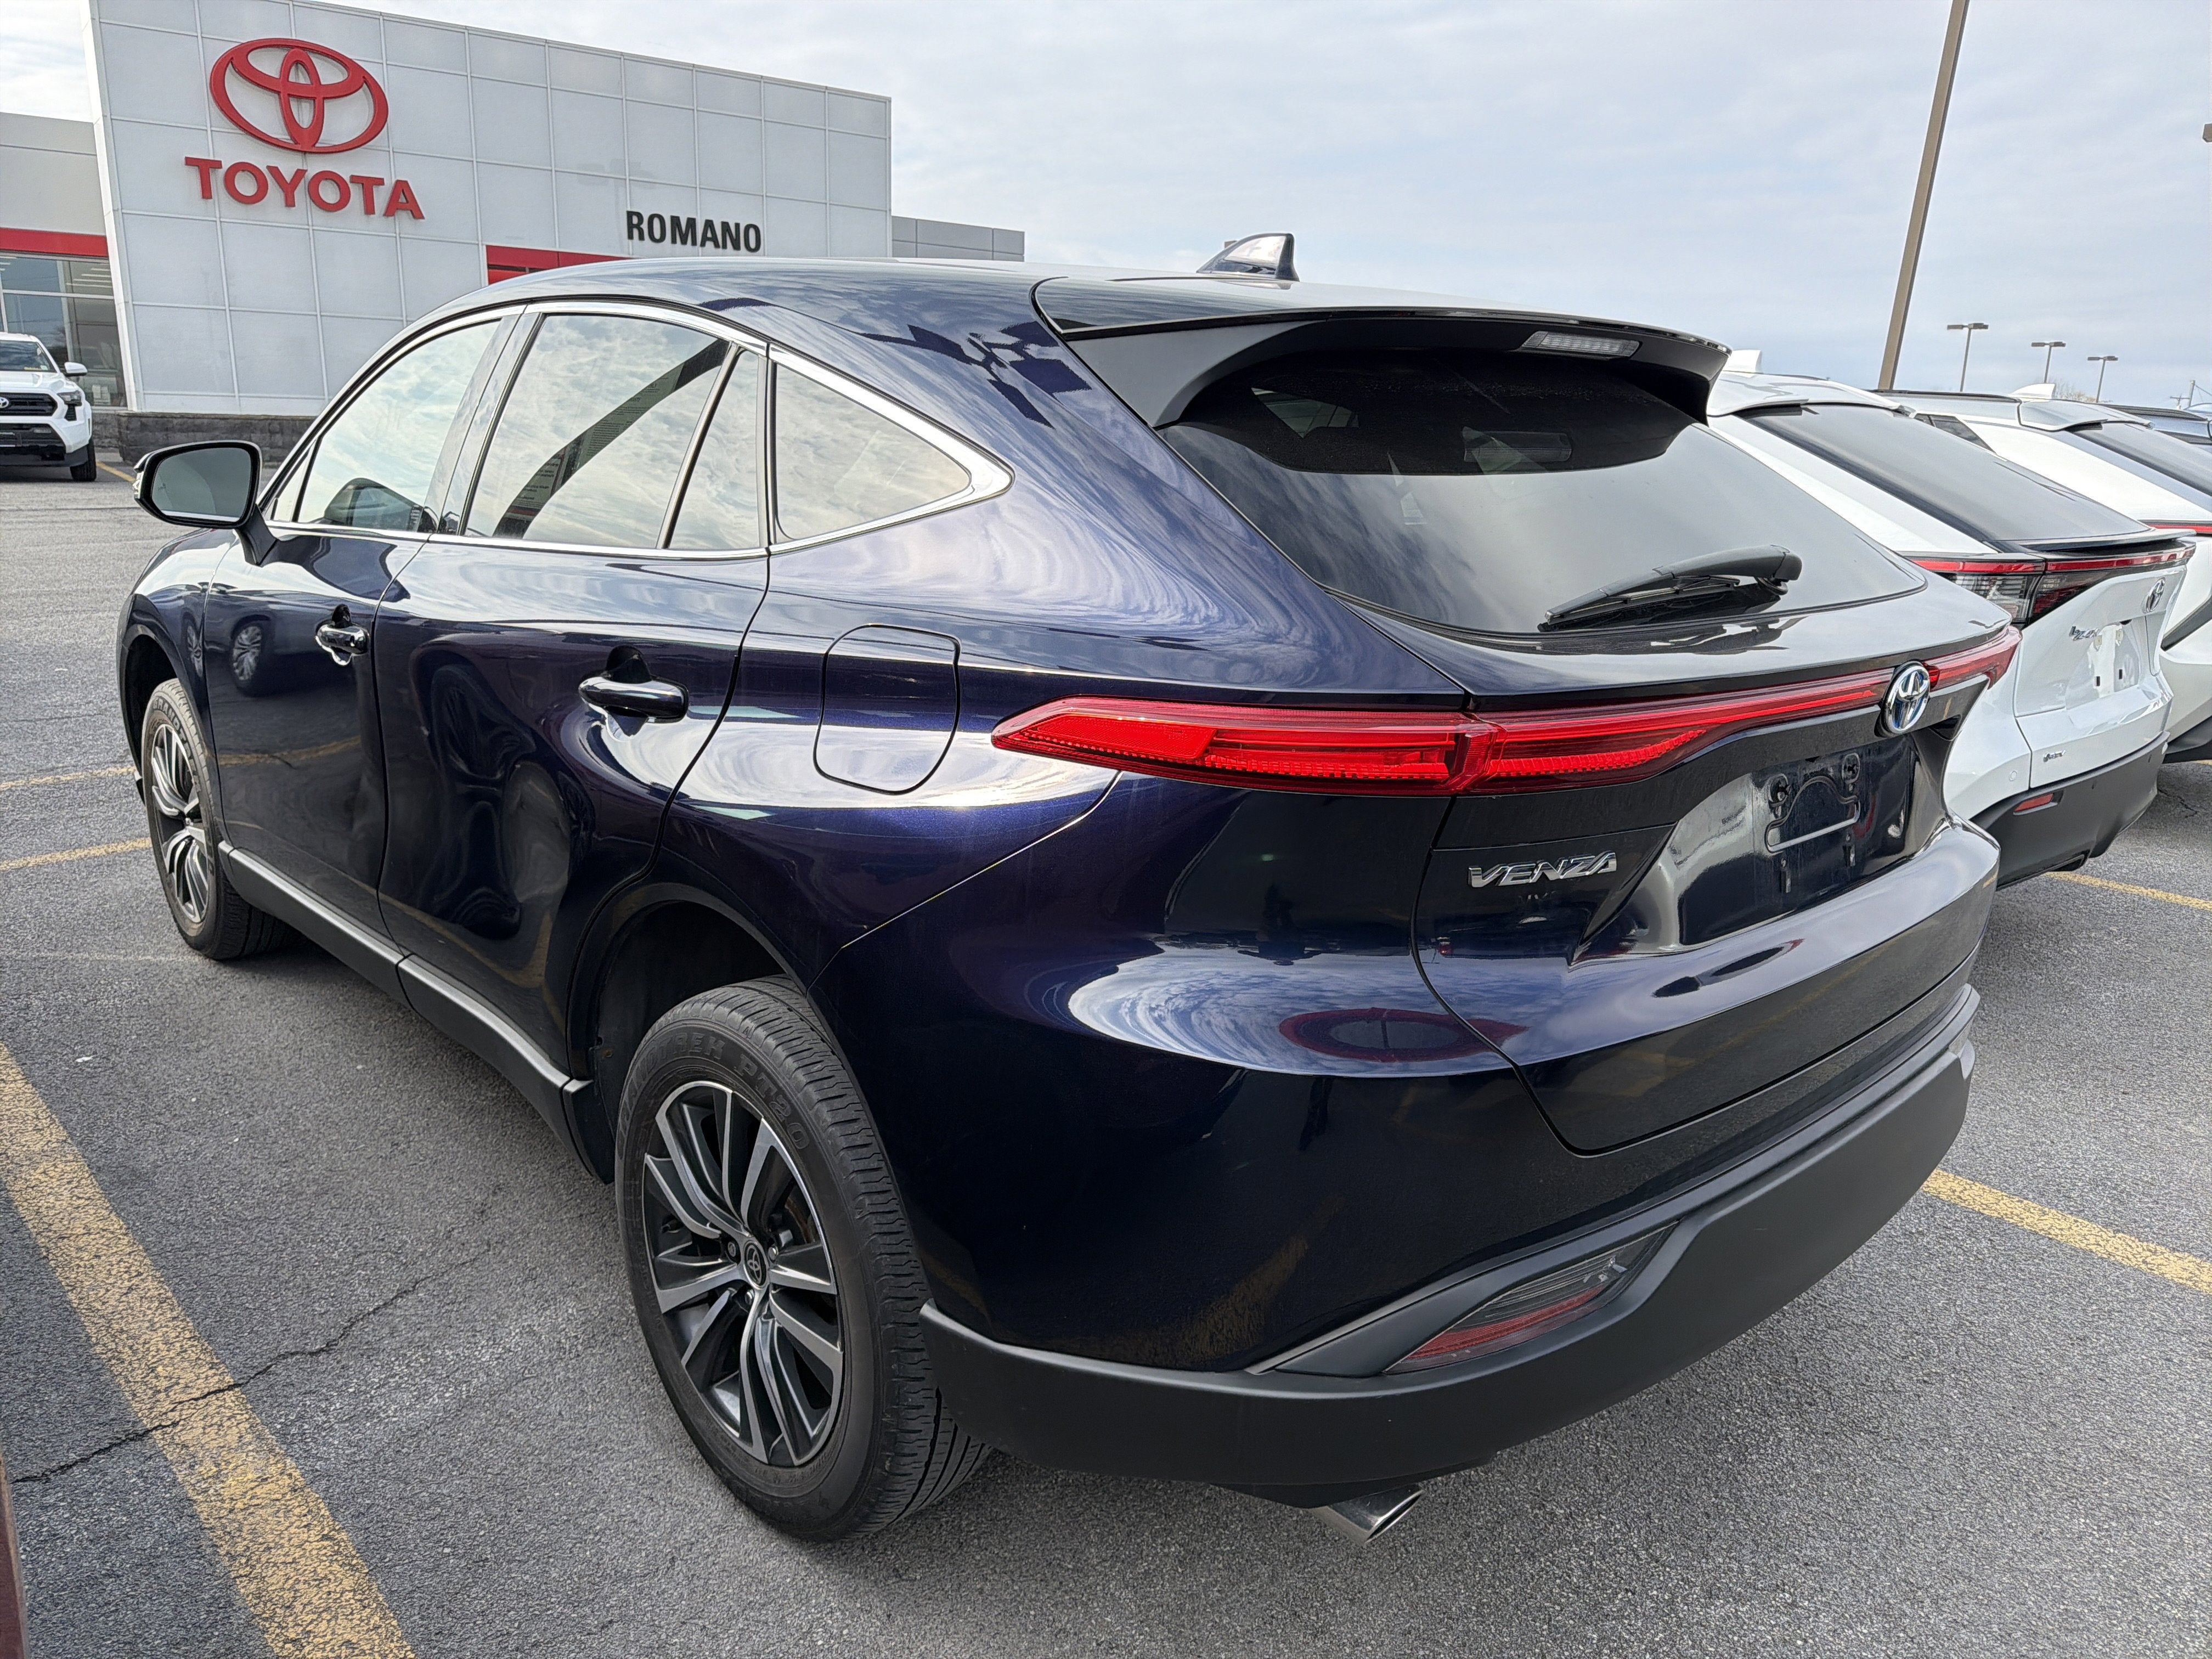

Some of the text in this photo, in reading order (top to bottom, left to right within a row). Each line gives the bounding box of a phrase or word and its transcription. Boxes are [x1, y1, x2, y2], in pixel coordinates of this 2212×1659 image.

[185, 156, 425, 219] TOYOTA
[626, 210, 761, 253] ROMANO
[1468, 851, 1617, 888] VENZA
[734, 1054, 810, 1150] PT20
